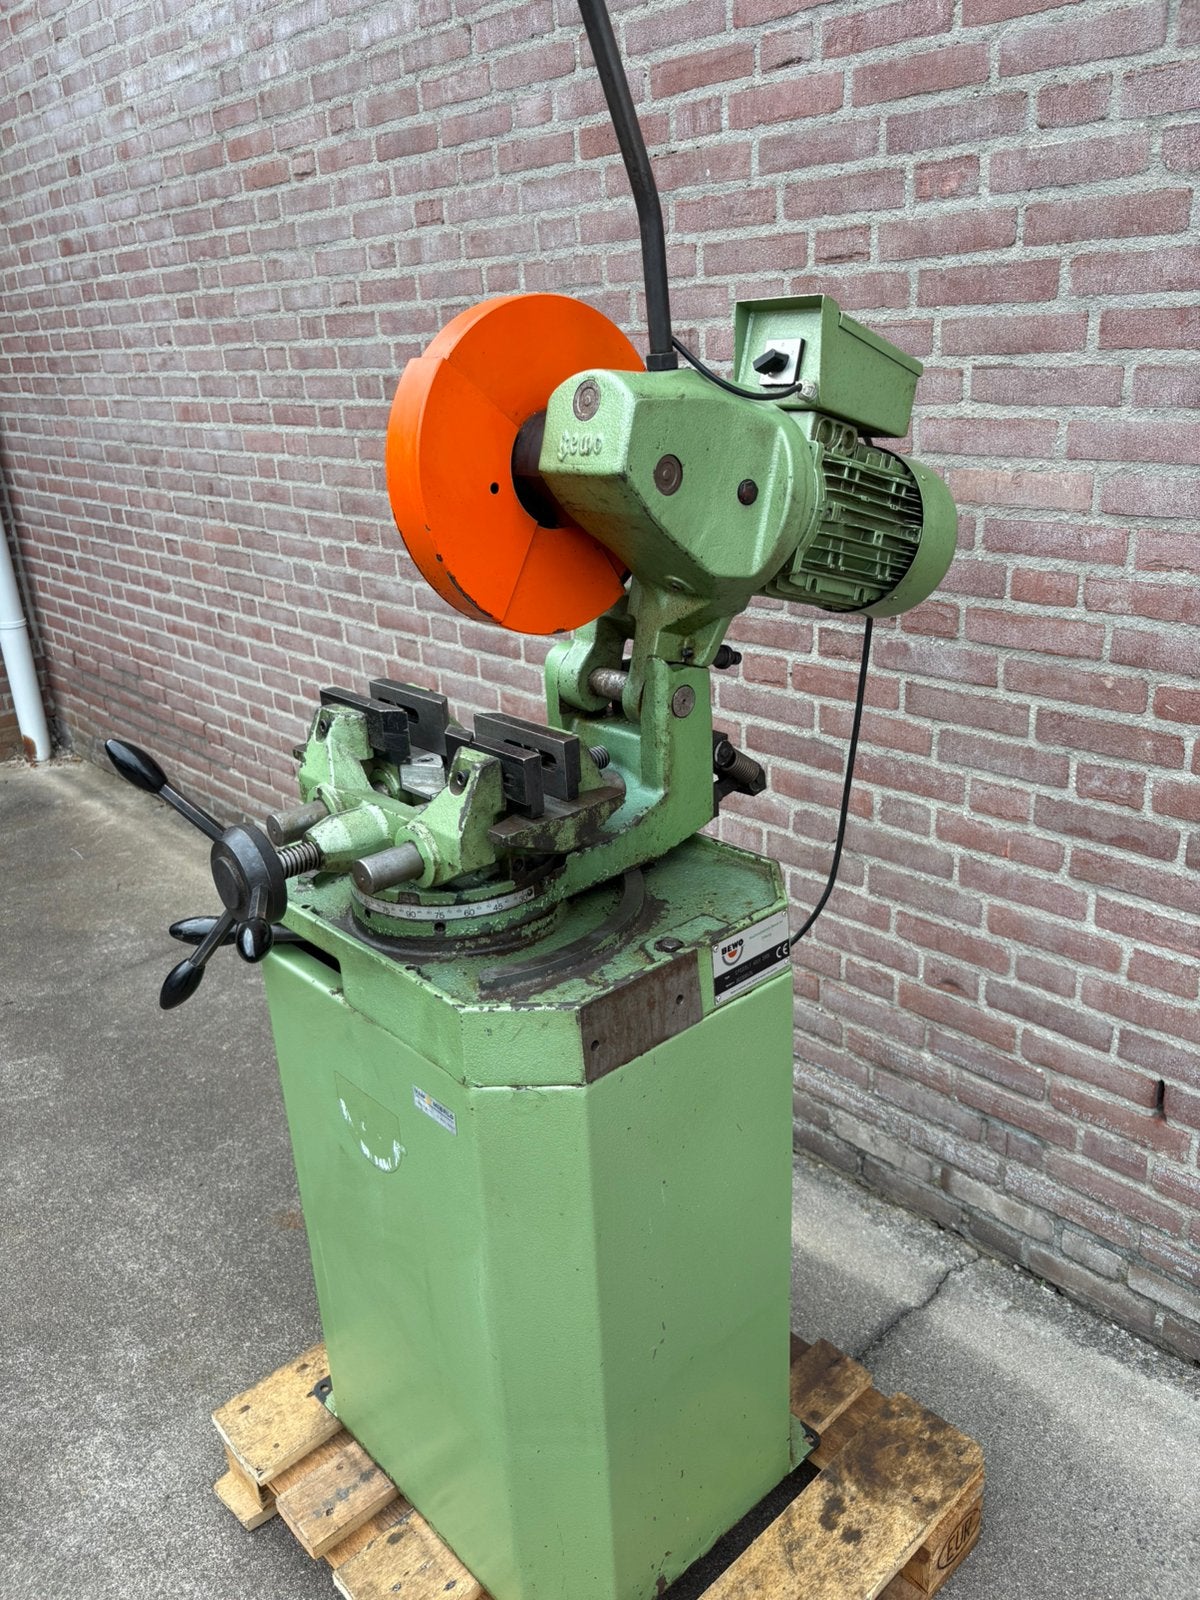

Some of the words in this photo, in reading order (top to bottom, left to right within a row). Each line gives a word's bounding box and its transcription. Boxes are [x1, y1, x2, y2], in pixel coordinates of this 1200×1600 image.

[405, 910, 417, 919] 90
[434, 911, 445, 919] 75
[463, 908, 475, 917] 60
[493, 903, 504, 911] 45
[721, 938, 744, 956] BEWO
[946, 1517, 973, 1562] EUR
